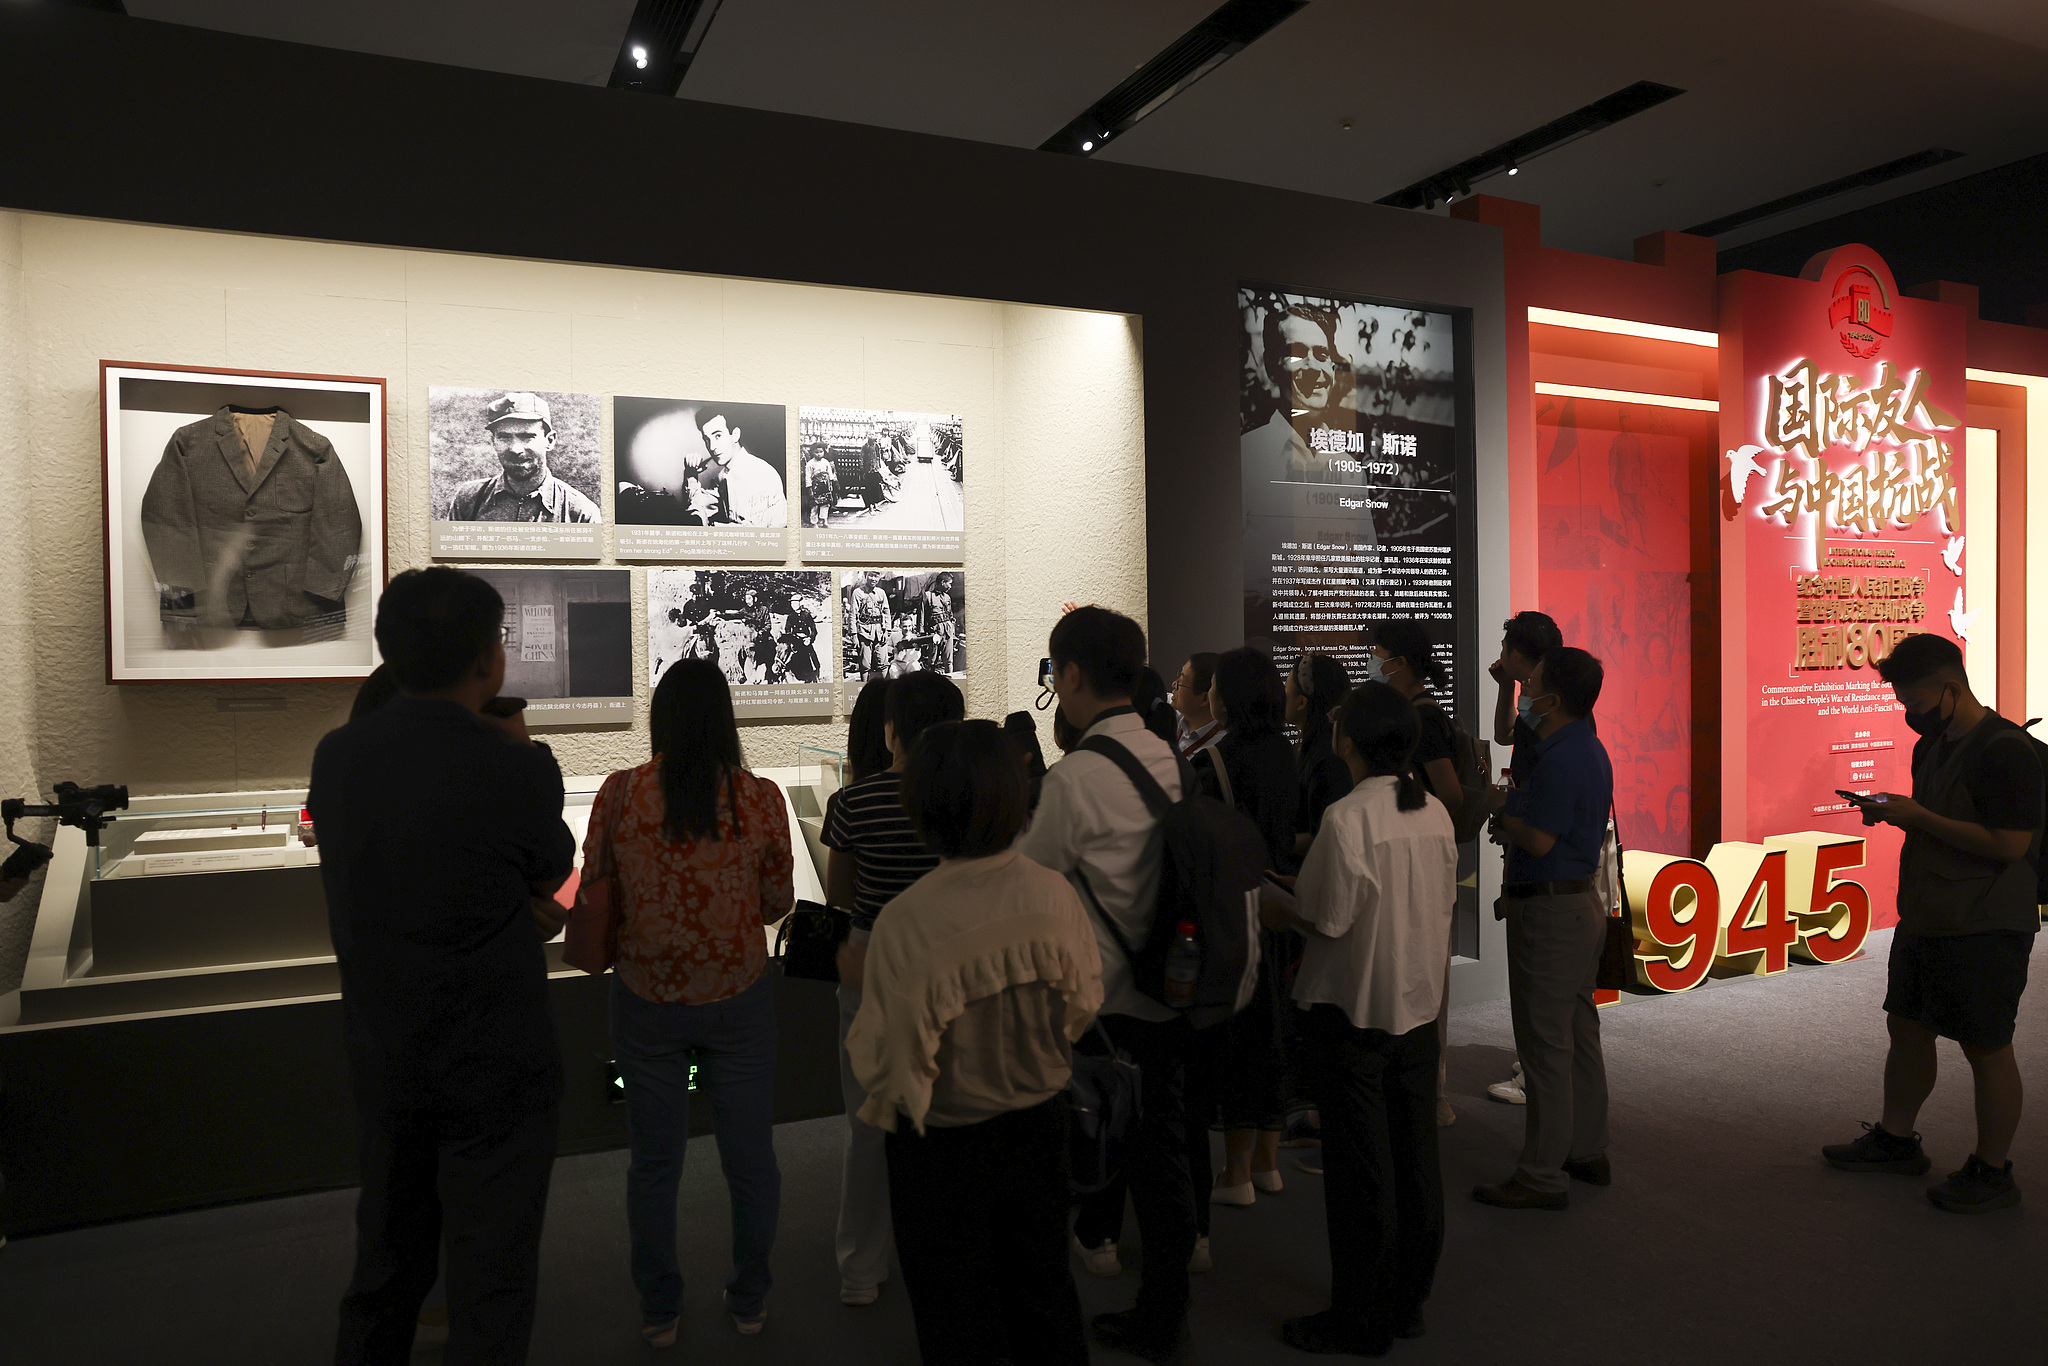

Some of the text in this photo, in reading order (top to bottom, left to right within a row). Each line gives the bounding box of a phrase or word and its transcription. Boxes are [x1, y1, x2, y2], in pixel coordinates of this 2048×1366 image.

[1857, 298, 1870, 323] 80
[1765, 358, 1962, 458] 国际友人
[1339, 498, 1364, 509] Edgar
[1365, 499, 1389, 509] Snow
[1762, 435, 1960, 570] 与中国抗战
[1829, 547, 1896, 558] INTERNATIONAL FRIENDS
[1797, 575, 1927, 598] 纪念中国人民抗日战争
[1797, 599, 1927, 622] 暨世界反法西斯战争
[1762, 683, 1813, 694] Commemorative
[1814, 682, 1845, 692] Exhibition
[1845, 681, 1870, 692] Marking
[1871, 680, 1880, 689] the
[1761, 698, 1768, 706] in
[1769, 697, 1780, 706] the
[1780, 696, 1806, 705] Chinese
[1831, 694, 1844, 703] War
[1844, 693, 1851, 702] of
[1852, 692, 1880, 702] Resistance
[1881, 692, 1897, 701] again
[1818, 706, 1829, 716] and
[1831, 705, 1840, 715] the
[1841, 705, 1859, 714] World
[1860, 703, 1893, 713] Anti-Fascist
[1593, 832, 1872, 1010] 945
